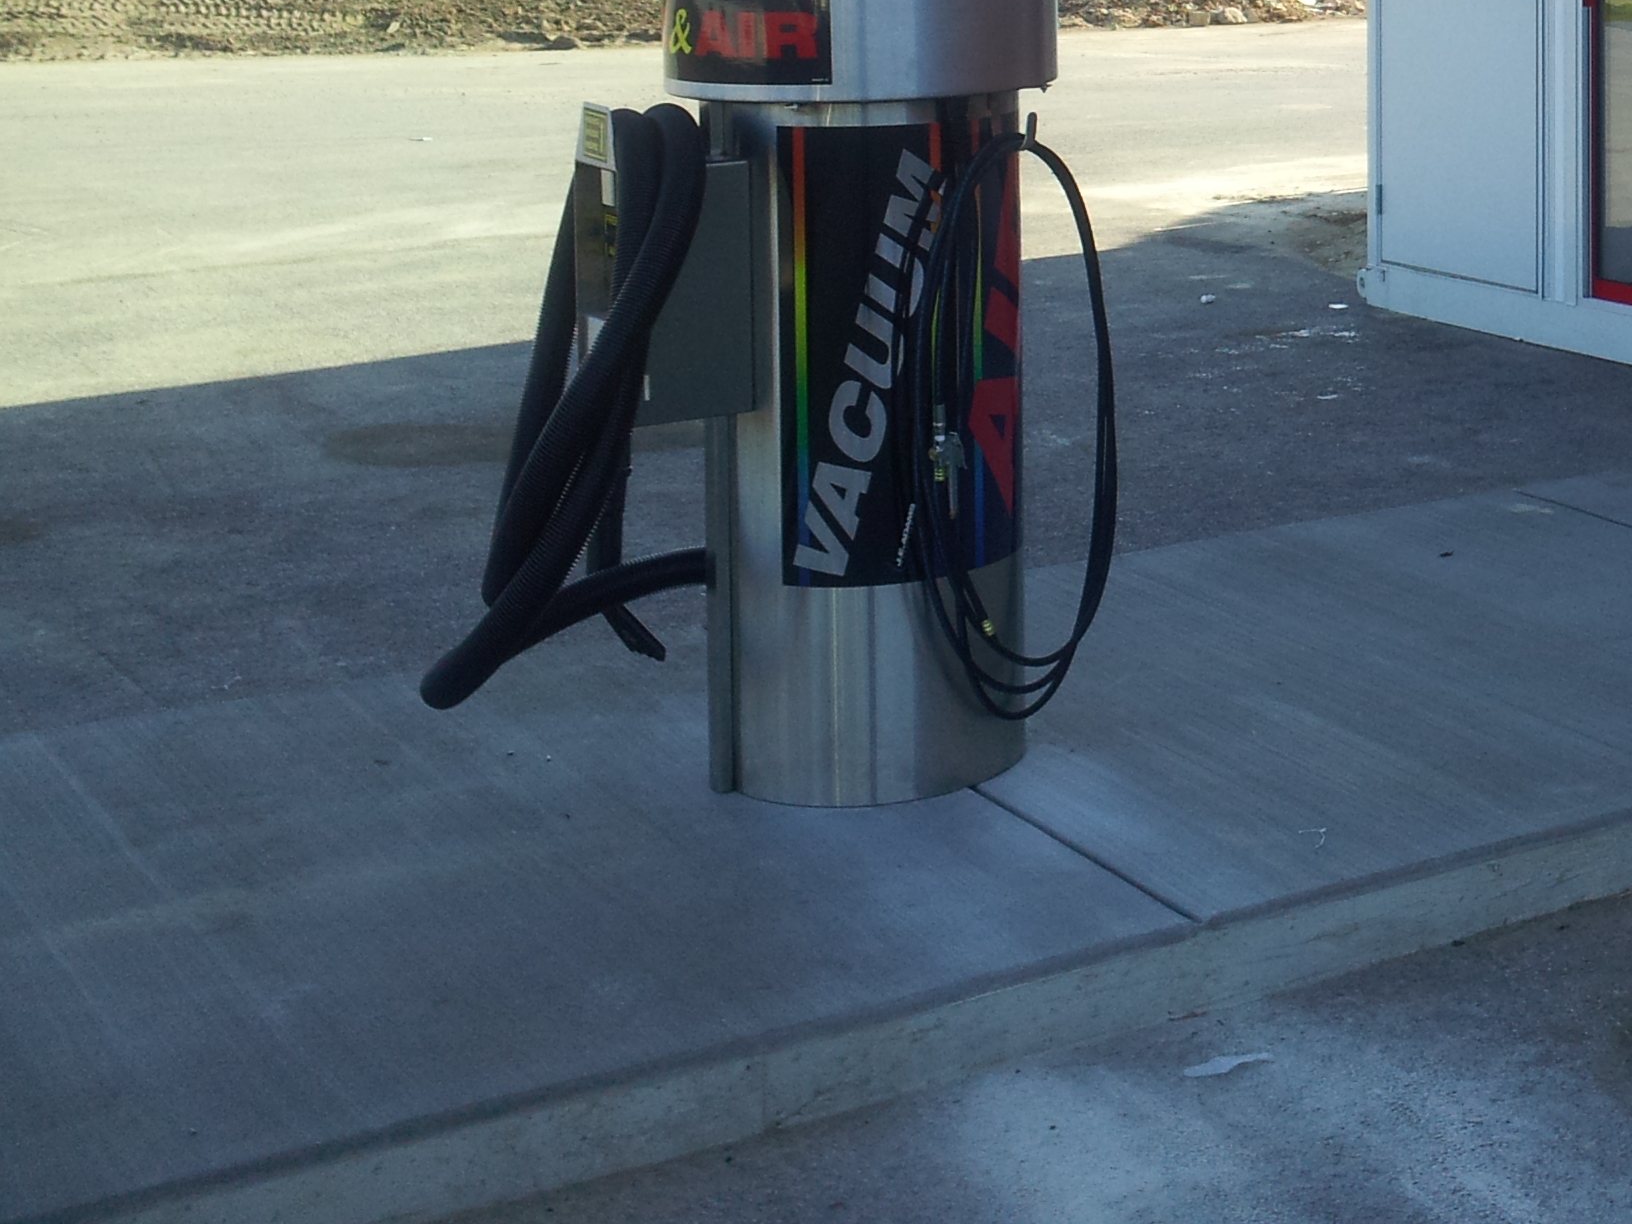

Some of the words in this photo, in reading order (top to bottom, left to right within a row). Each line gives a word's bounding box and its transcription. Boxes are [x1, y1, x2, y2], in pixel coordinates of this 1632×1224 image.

[669, 8, 692, 55] &
[694, 10, 819, 60] AIR
[792, 148, 950, 576] VACUUM
